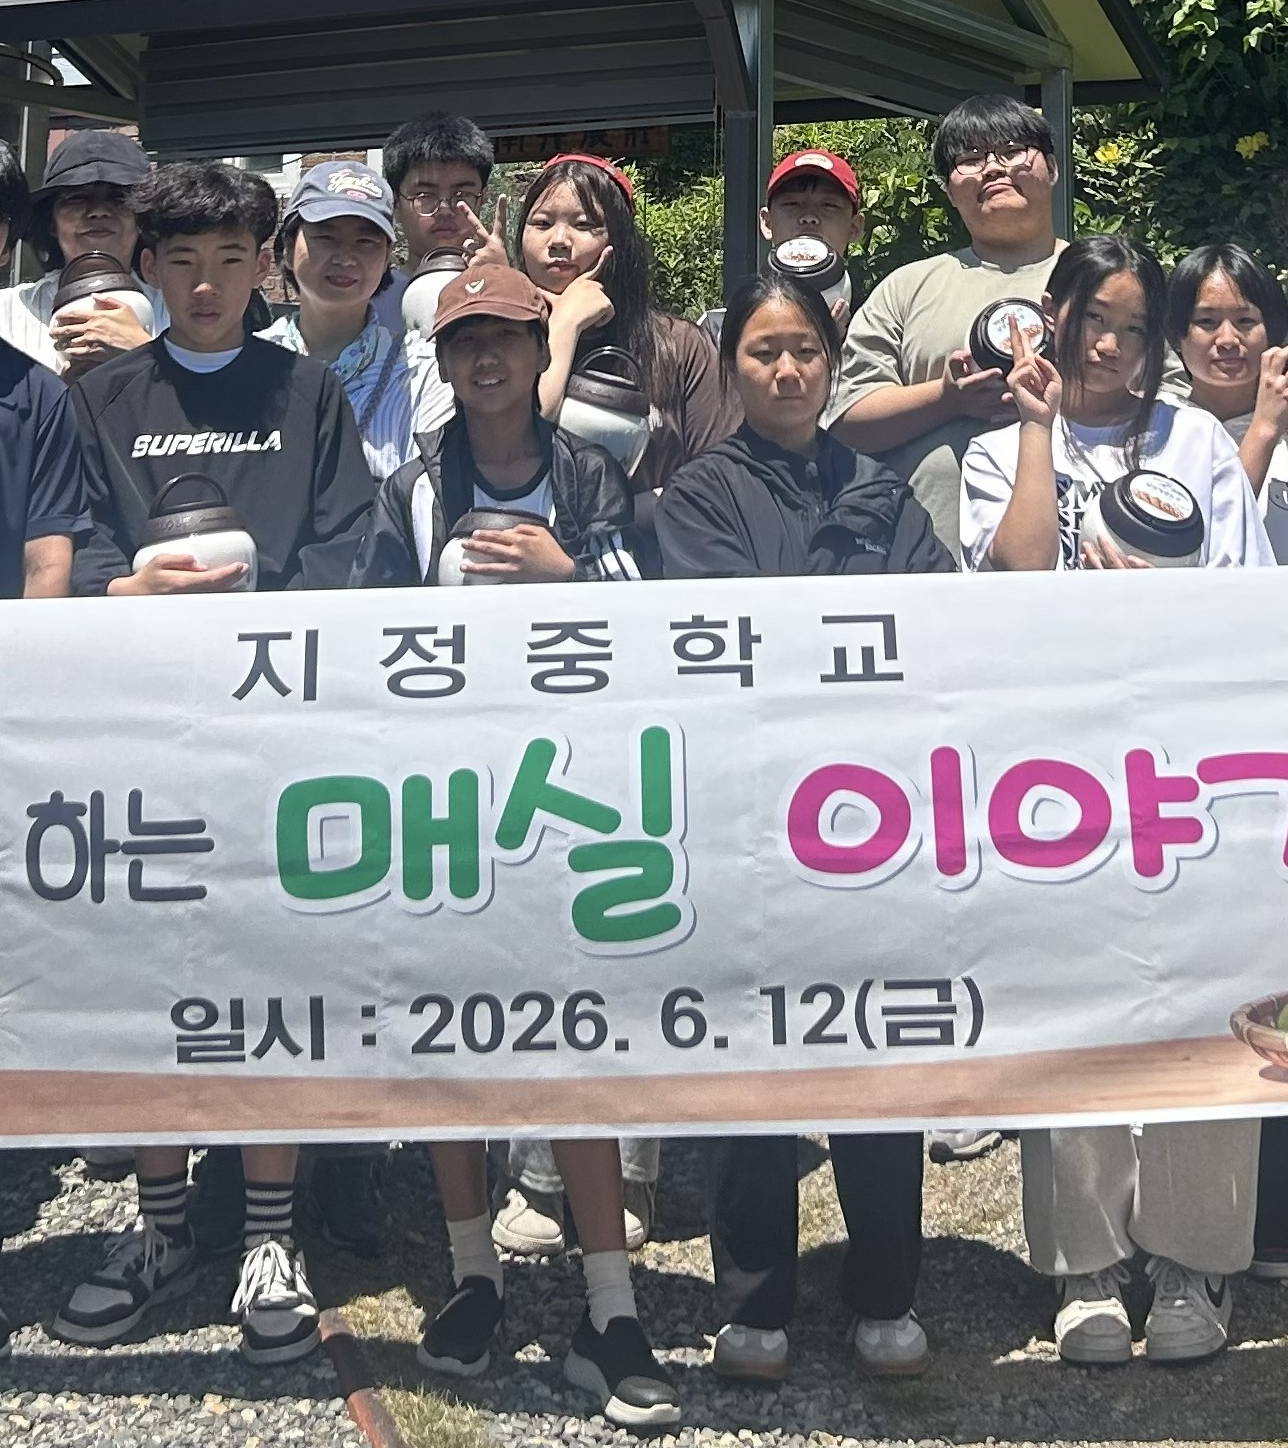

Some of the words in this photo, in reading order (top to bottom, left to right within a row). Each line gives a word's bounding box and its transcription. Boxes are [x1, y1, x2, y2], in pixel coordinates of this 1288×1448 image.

[131, 430, 282, 459] SUPERILLA
[25, 789, 215, 904] 하는
[275, 725, 685, 943] 매실
[170, 995, 325, 1064] 일시
[409, 990, 630, 1055] 2026.
[660, 987, 729, 1052] 6.
[759, 977, 985, 1050] 12(금)
